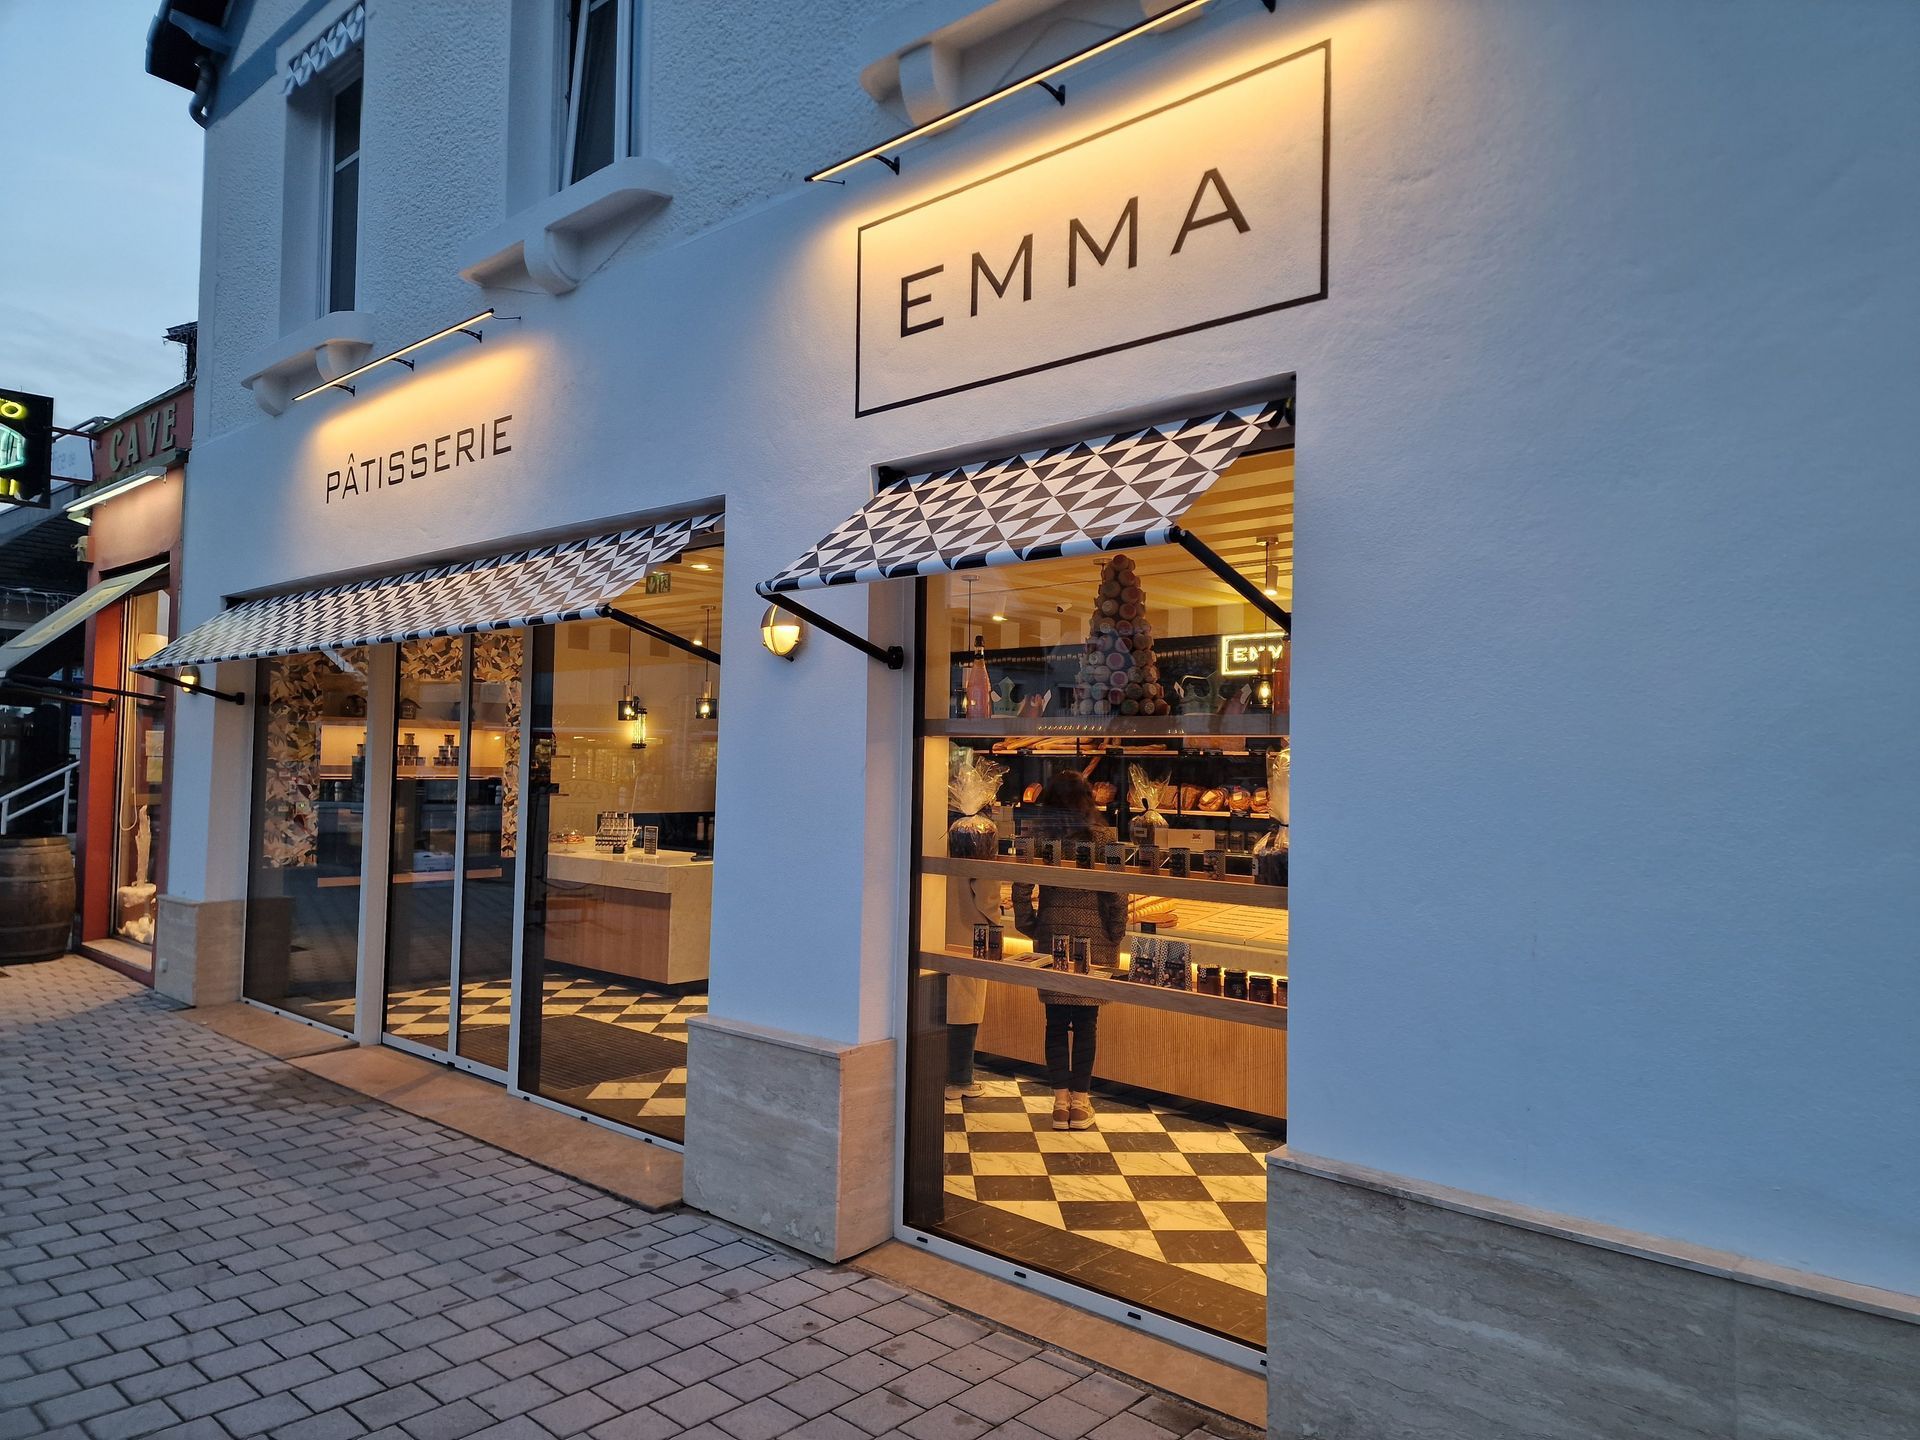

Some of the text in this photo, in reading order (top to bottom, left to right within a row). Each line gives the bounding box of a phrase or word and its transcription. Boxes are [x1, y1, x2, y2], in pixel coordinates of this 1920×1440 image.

[901, 168, 1251, 338] EMMA
[109, 402, 176, 472] CAVE
[326, 415, 512, 504] PÂTISSERIE
